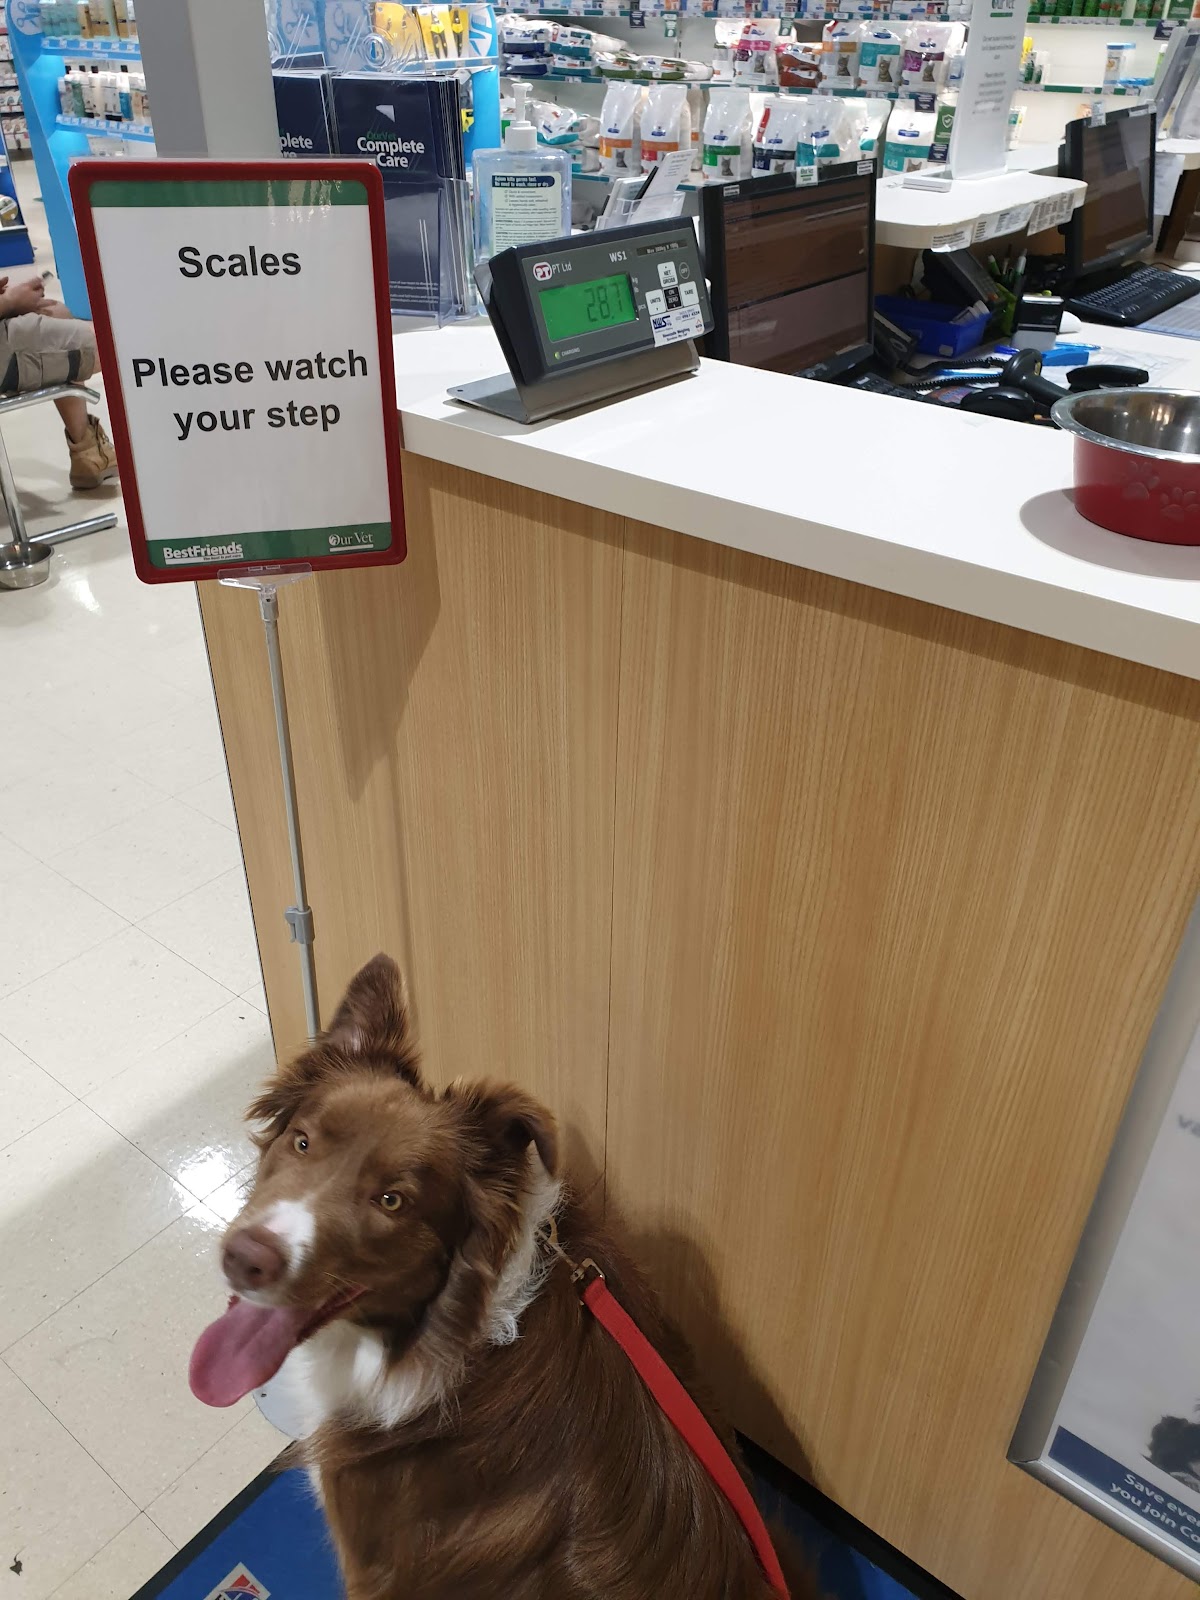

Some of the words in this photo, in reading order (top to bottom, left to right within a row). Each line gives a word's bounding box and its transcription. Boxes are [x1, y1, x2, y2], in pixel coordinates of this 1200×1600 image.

[280, 132, 313, 150] plete
[356, 136, 425, 155] Complete
[376, 153, 409, 168] Care
[178, 245, 302, 278] Scales
[609, 251, 628, 263] WS1
[552, 264, 561, 274] PT
[561, 263, 572, 272] Ltd
[132, 357, 255, 388] Please
[264, 349, 369, 382] watch
[173, 407, 256, 441] your
[267, 399, 341, 432] step
[353, 531, 374, 544] Vet
[163, 541, 243, 559] BestFriends
[1124, 1473, 1165, 1504] Save
[1110, 1482, 1142, 1507] you
[1141, 1502, 1177, 1529] join
